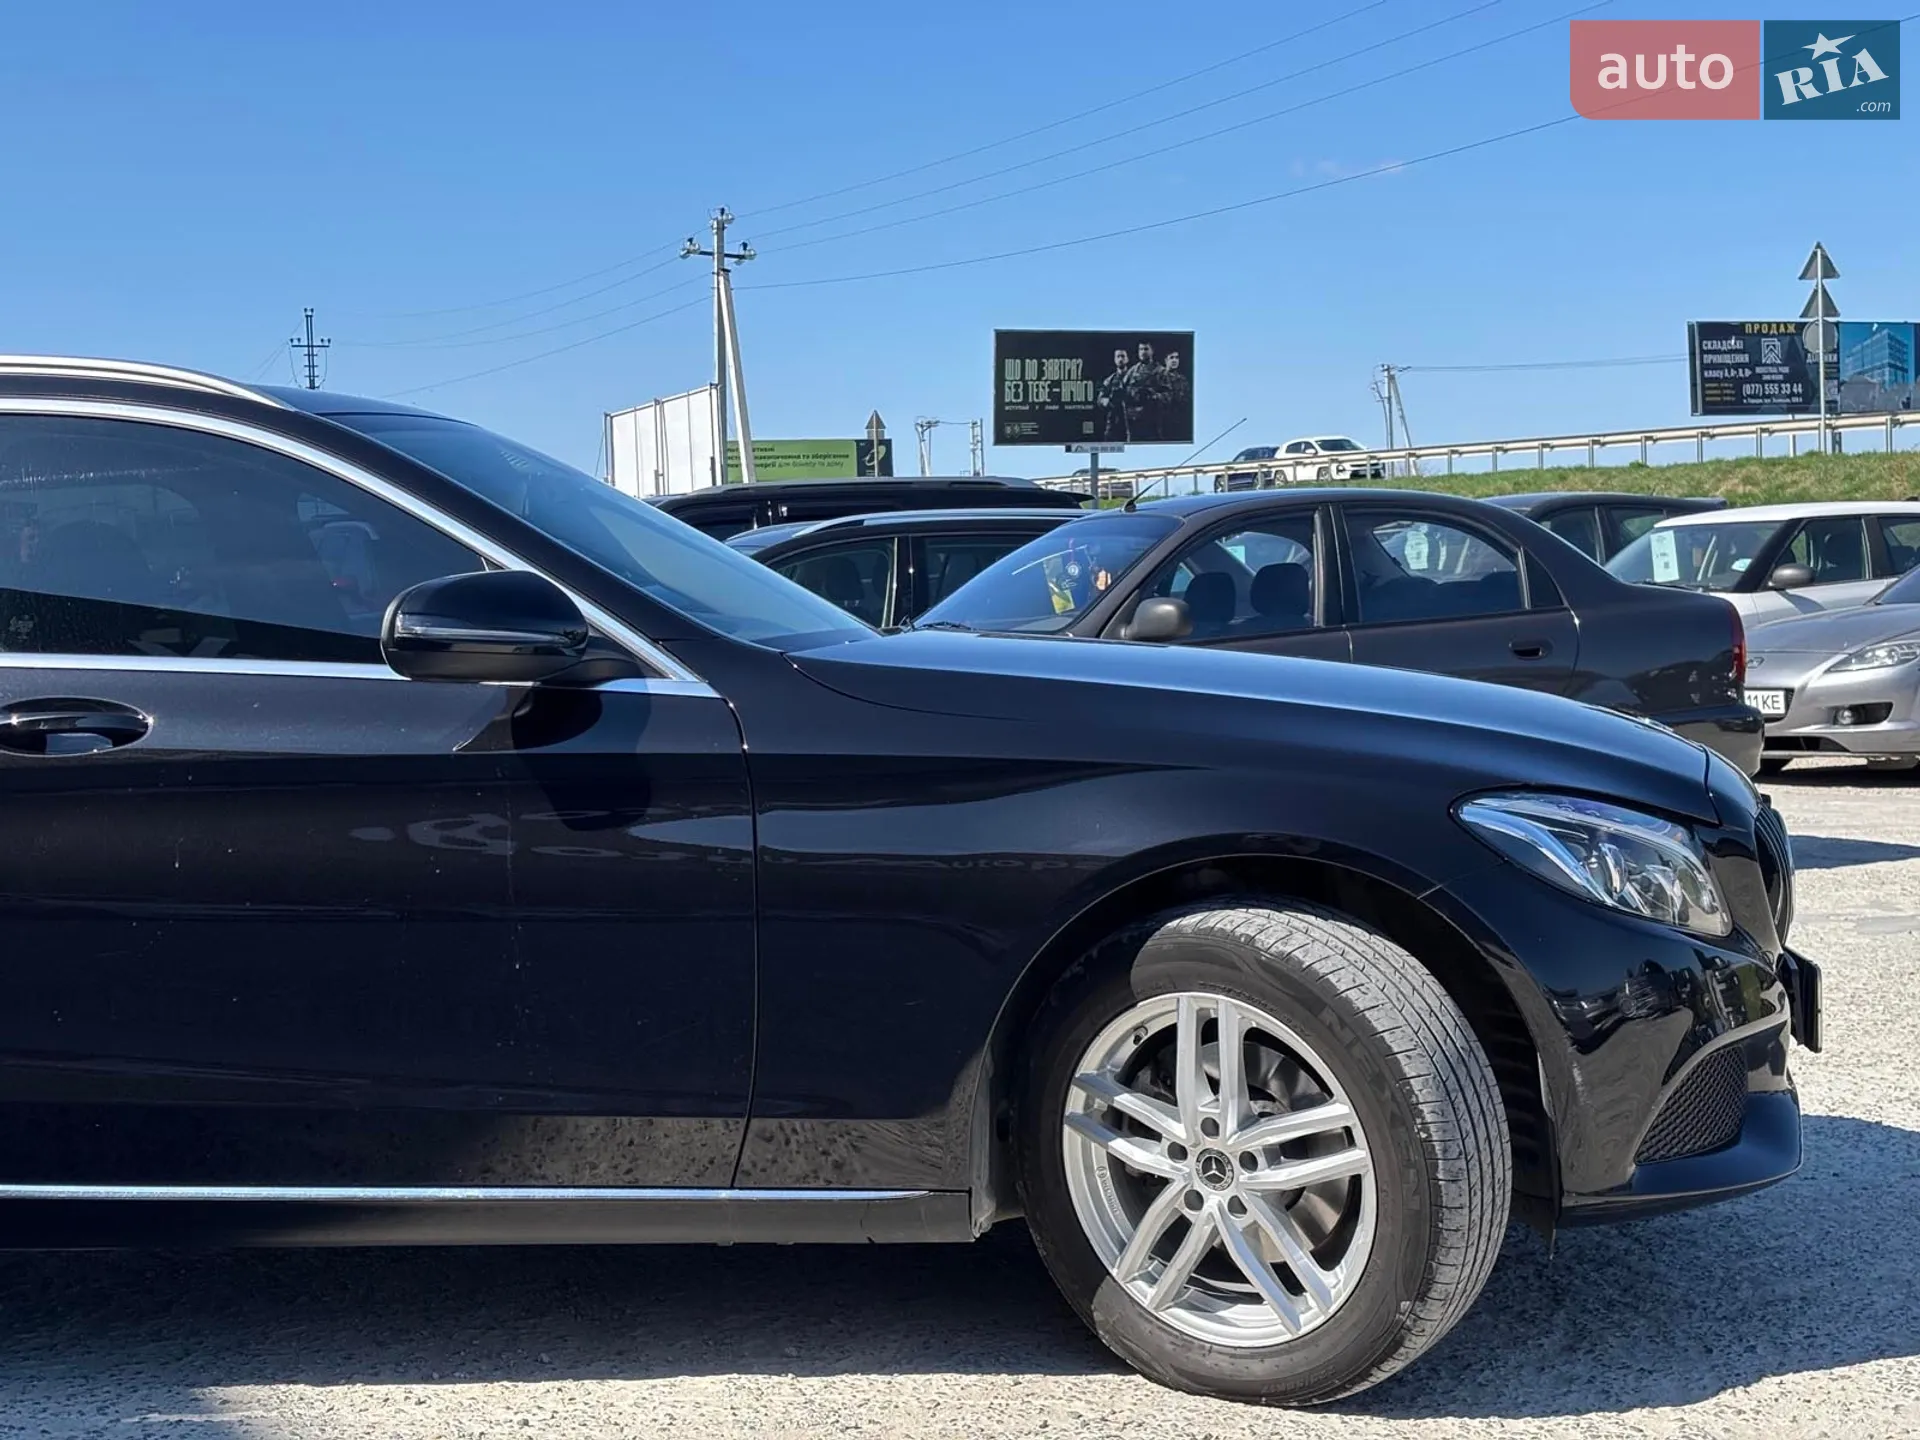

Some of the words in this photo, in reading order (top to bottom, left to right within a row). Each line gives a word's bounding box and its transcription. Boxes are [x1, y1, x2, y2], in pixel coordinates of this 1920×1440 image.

[1745, 323, 1796, 335] ПРОДАЖ
[1025, 358, 1038, 380] ПО
[1004, 381, 1024, 402] БЕЗ
[1028, 381, 1052, 402] ТЕБЕ
[1742, 383, 1762, 397] (077)
[1764, 383, 1779, 394] 555
[1781, 383, 1791, 394] 33
[1792, 383, 1802, 394] 44
